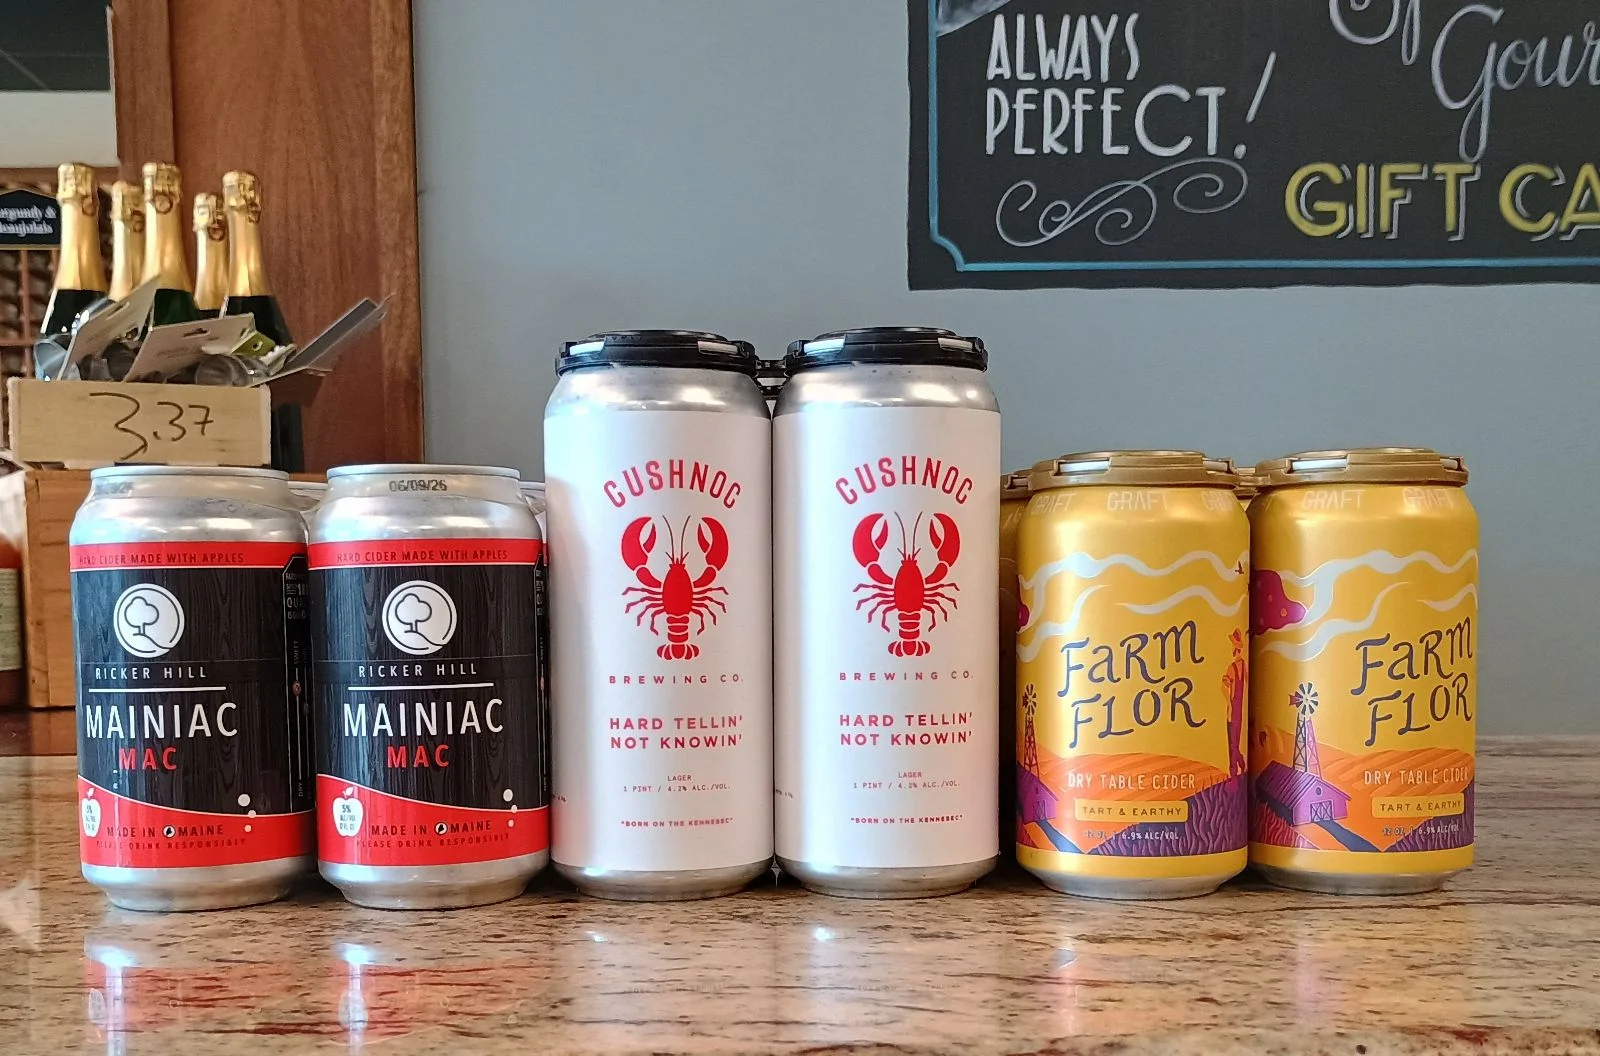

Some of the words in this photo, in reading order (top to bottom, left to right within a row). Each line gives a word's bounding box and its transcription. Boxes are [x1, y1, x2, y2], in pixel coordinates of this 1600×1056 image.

[987, 13, 1141, 82] ALWAYS
[986, 51, 1277, 160] PERFECT!
[1284, 162, 1482, 241] GIFT
[1499, 162, 1600, 241] CA
[89, 391, 214, 460] 3.37
[603, 459, 741, 509] CUSHNOC
[835, 456, 973, 505] CUSHNOC
[1106, 490, 1170, 511] GRAFT
[1302, 489, 1368, 511] GRAFT
[99, 554, 126, 565] CIDER
[131, 553, 161, 564] MADE
[167, 552, 197, 563] WITH
[202, 552, 244, 563] APPLES
[337, 553, 361, 562] HARD
[365, 552, 397, 561] CIDER
[402, 551, 434, 560] MADE
[440, 550, 468, 561] WITH
[473, 550, 508, 560] APPLES
[95, 667, 151, 680] RICKER
[163, 666, 207, 679] HILL
[359, 665, 423, 677] RICKER
[436, 663, 477, 676] HILL
[839, 672, 938, 681] BREWING
[951, 670, 974, 680] CO.
[609, 675, 708, 684] BREWING
[720, 673, 744, 683] CO.
[1069, 677, 1206, 749] FLOR
[1364, 672, 1473, 747] FLOR
[86, 702, 238, 739] MAINIAC
[343, 698, 504, 737] MAINIAC
[609, 717, 663, 730] HARD
[674, 715, 743, 730] TELLIN'
[839, 714, 894, 727] HARD
[905, 712, 972, 726] TELLIN'
[610, 737, 649, 749] NOT
[660, 734, 742, 749] KNOWIN'
[840, 733, 879, 746] NOT
[890, 731, 972, 746] KNOWIN'
[119, 747, 177, 770] MAC
[387, 744, 450, 769] MAC
[922, 780, 961, 788] ALC./VOL.
[1068, 771, 1092, 788] DRY
[1100, 773, 1147, 790] TABLE
[1152, 773, 1195, 790] CIDER
[1364, 770, 1391, 785] DRY
[1399, 768, 1439, 784] TABLE
[341, 804, 352, 813] 5%
[1082, 806, 1112, 816] TART
[1118, 807, 1126, 816] &
[1132, 807, 1181, 816] EARTHY
[1380, 803, 1410, 812] TART
[1416, 803, 1422, 811] &
[1427, 800, 1461, 810] EARTHY
[107, 827, 136, 837] MADE
[143, 827, 155, 837] IN
[179, 825, 223, 836] MAINE
[371, 825, 406, 836] MADE
[414, 824, 427, 835] IN
[450, 820, 491, 833] MAINE
[1121, 831, 1142, 840] 6.9%
[1144, 830, 1179, 841] ALC/VOL
[1418, 826, 1435, 836] 6.9%
[129, 842, 161, 850] DRINK
[167, 838, 245, 849] RESPONSIBLY
[399, 839, 432, 848] DRINK
[440, 832, 509, 847] RESPONSIBLY
